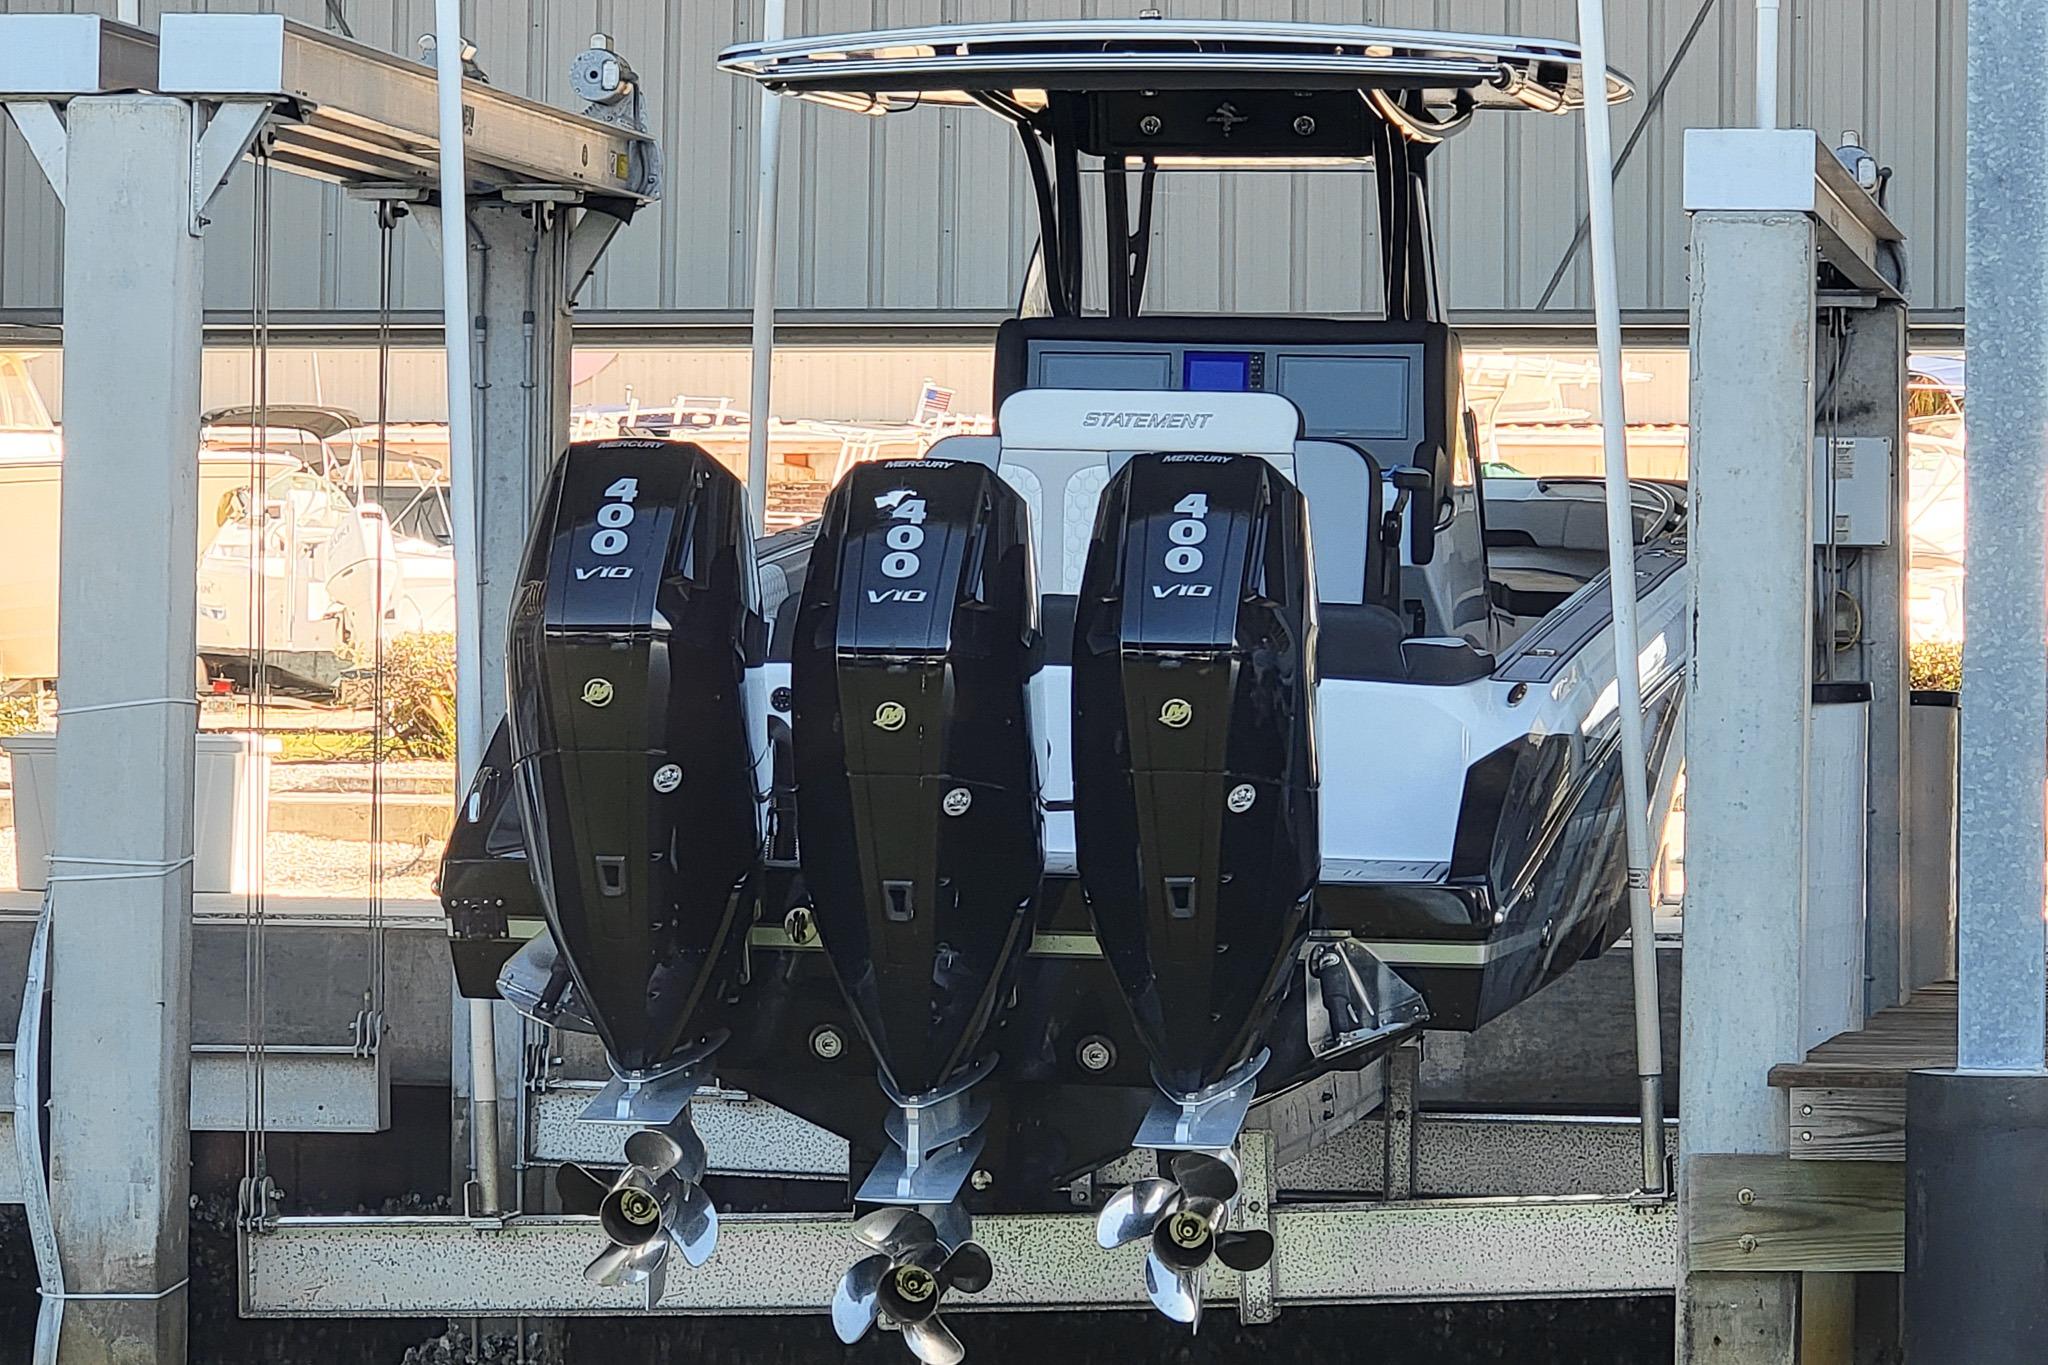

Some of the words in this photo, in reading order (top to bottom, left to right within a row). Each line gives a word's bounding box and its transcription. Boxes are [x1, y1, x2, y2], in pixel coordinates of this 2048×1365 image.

[1083, 412, 1213, 429] STATEMENT
[598, 440, 666, 449] MERCURY
[884, 461, 955, 469] MERCURY
[1162, 454, 1233, 464] MERCURY
[590, 477, 639, 556] 400
[881, 499, 927, 579] 400
[1164, 493, 1209, 574] 400
[575, 566, 634, 580] V10
[867, 588, 928, 604] V10
[1152, 584, 1213, 599] V10
